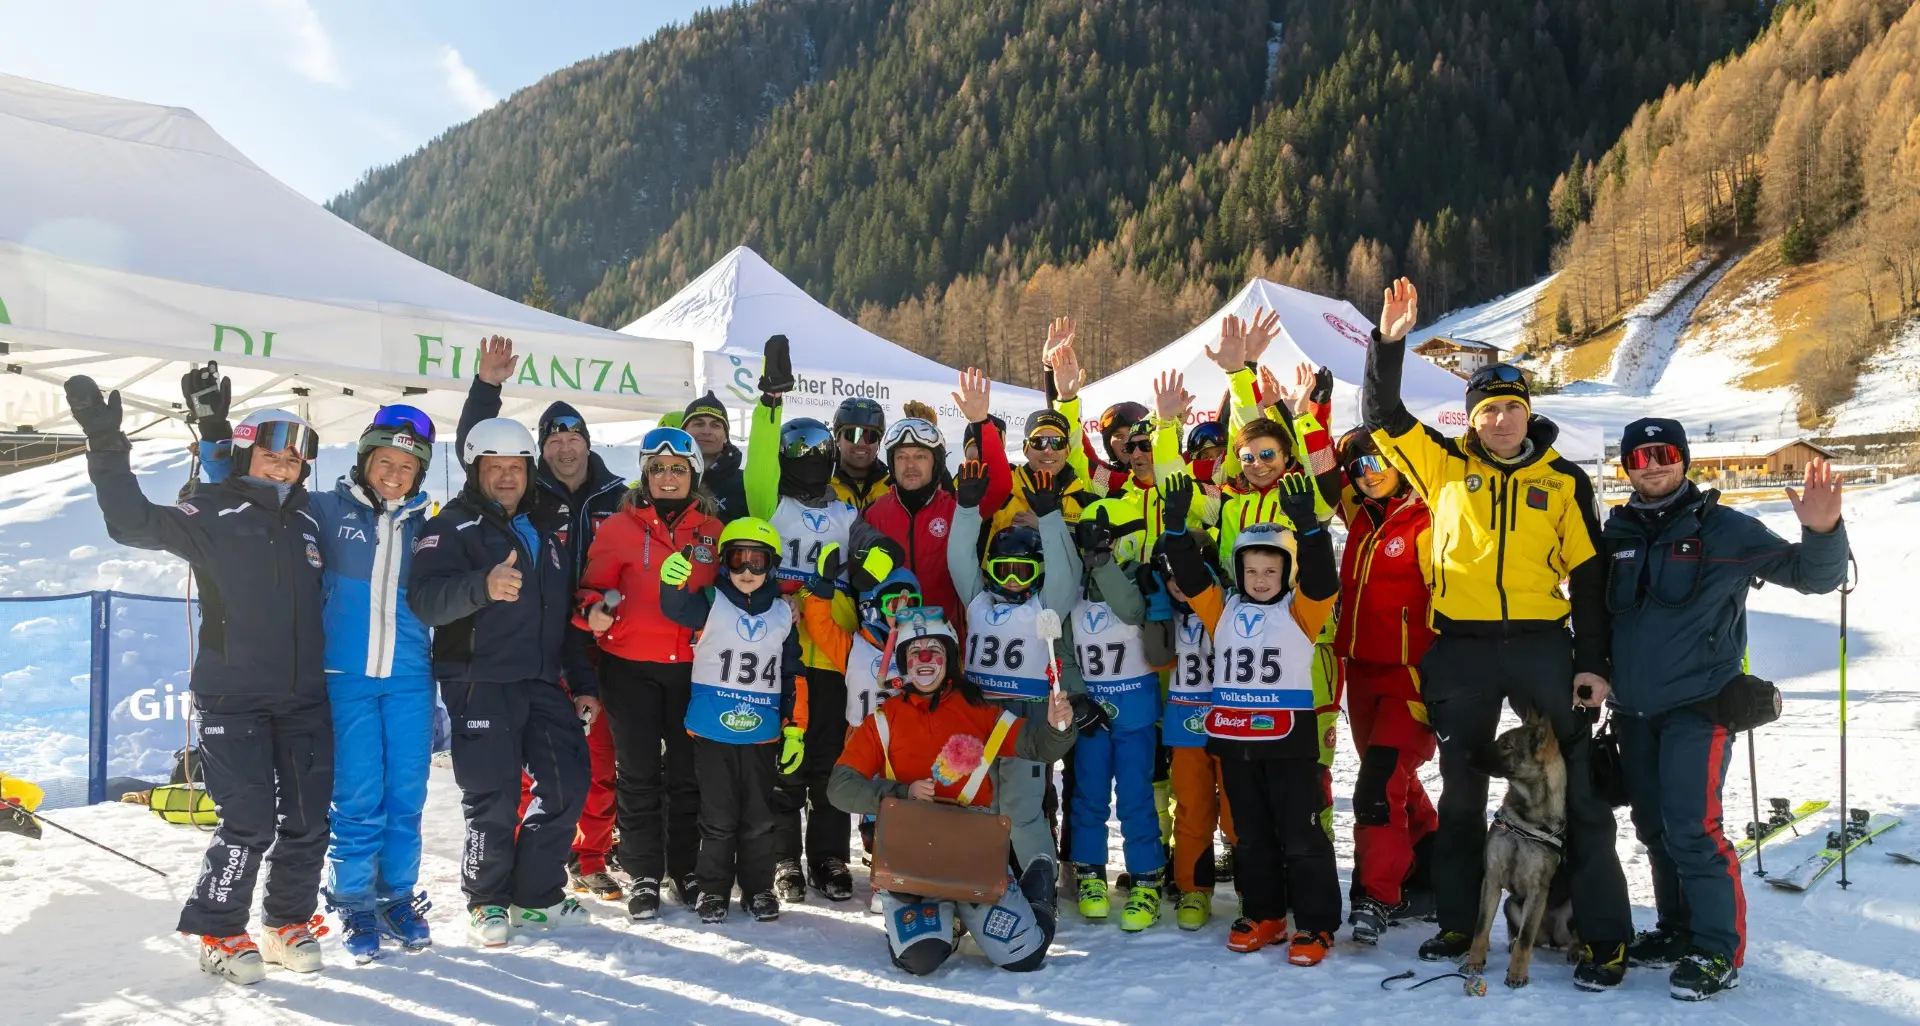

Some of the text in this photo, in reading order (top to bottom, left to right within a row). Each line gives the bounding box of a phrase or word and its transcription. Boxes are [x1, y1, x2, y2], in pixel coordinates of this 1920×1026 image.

[413, 333, 643, 395] FIANZA
[832, 377, 891, 400] Rodeln
[805, 397, 835, 407] SICURO
[1185, 411, 1217, 426] OCE
[337, 525, 377, 543] ITA
[788, 539, 825, 568] 14
[966, 634, 1025, 671] 136
[1076, 641, 1126, 677] 137
[718, 648, 778, 689] 134
[1223, 646, 1282, 685] 135
[1097, 682, 1143, 695] Popolare
[1220, 691, 1280, 704] Volksbank
[129, 683, 196, 721] Git
[204, 725, 225, 735] COLMAR
[467, 720, 490, 729] COLMAR
[726, 714, 757, 727] Brimi
